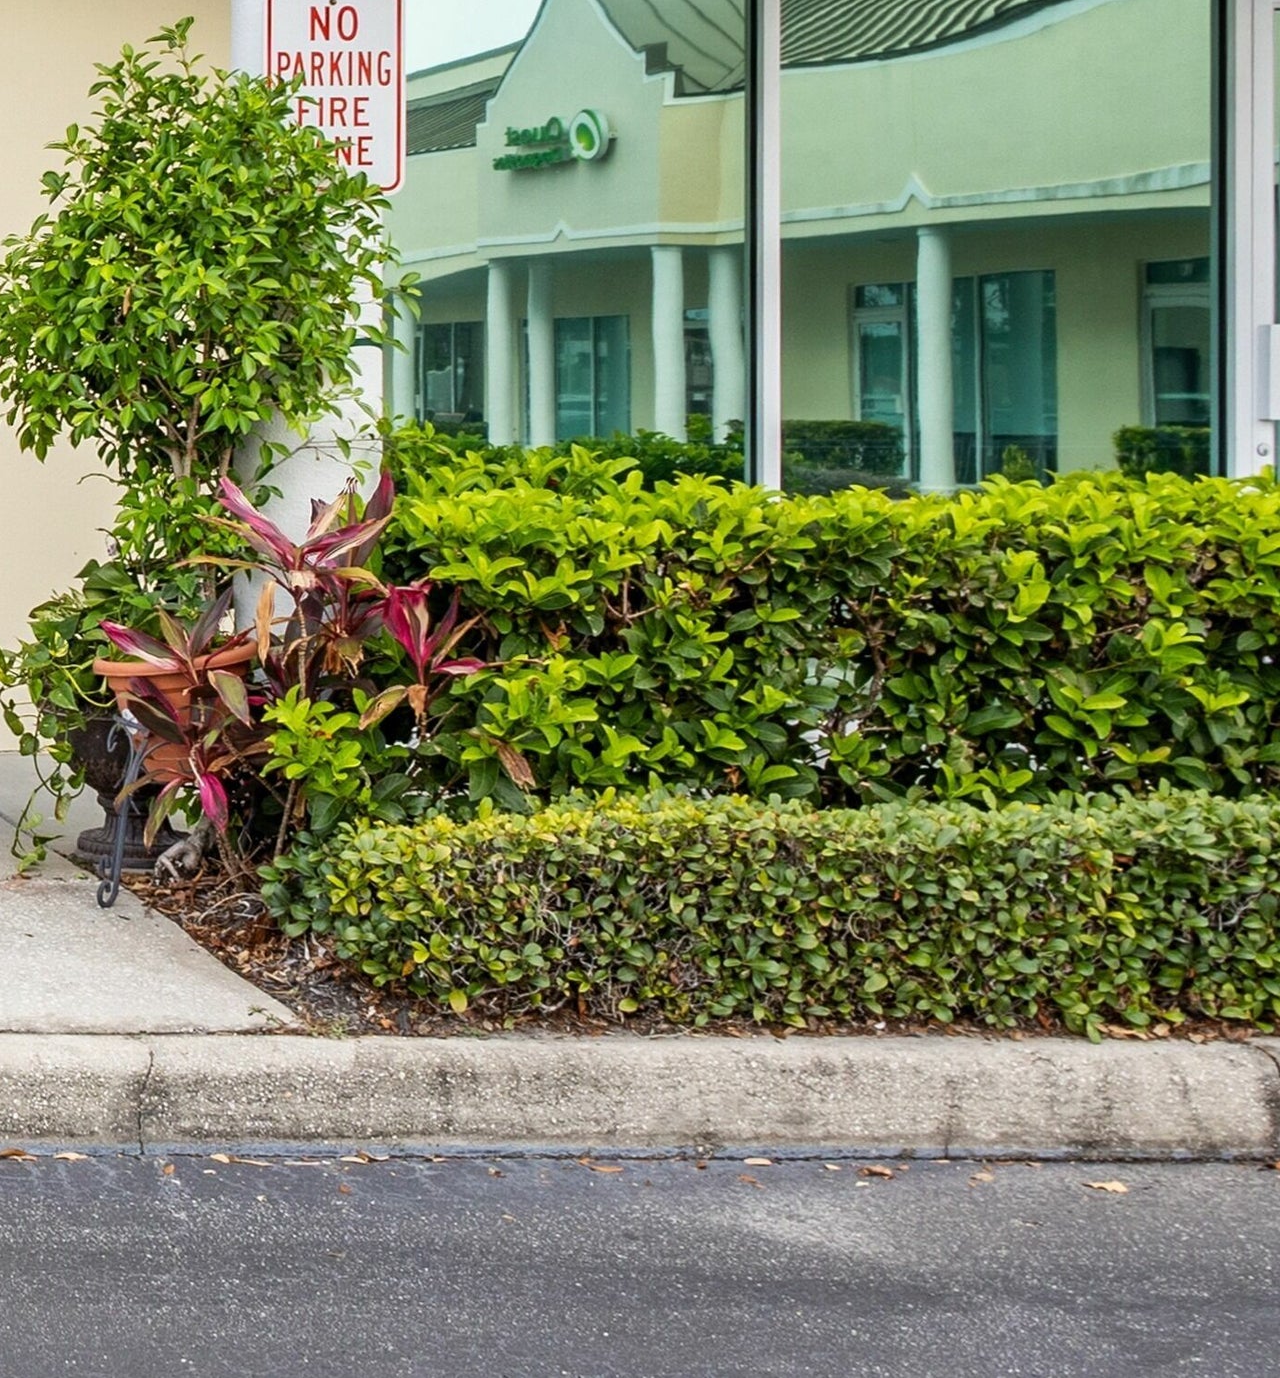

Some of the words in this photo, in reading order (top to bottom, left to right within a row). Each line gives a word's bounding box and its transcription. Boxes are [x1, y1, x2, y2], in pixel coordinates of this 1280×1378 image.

[309, 5, 359, 42] NO
[277, 50, 392, 87] PARKING
[297, 96, 370, 128] FIRE
[316, 135, 374, 167] NE
